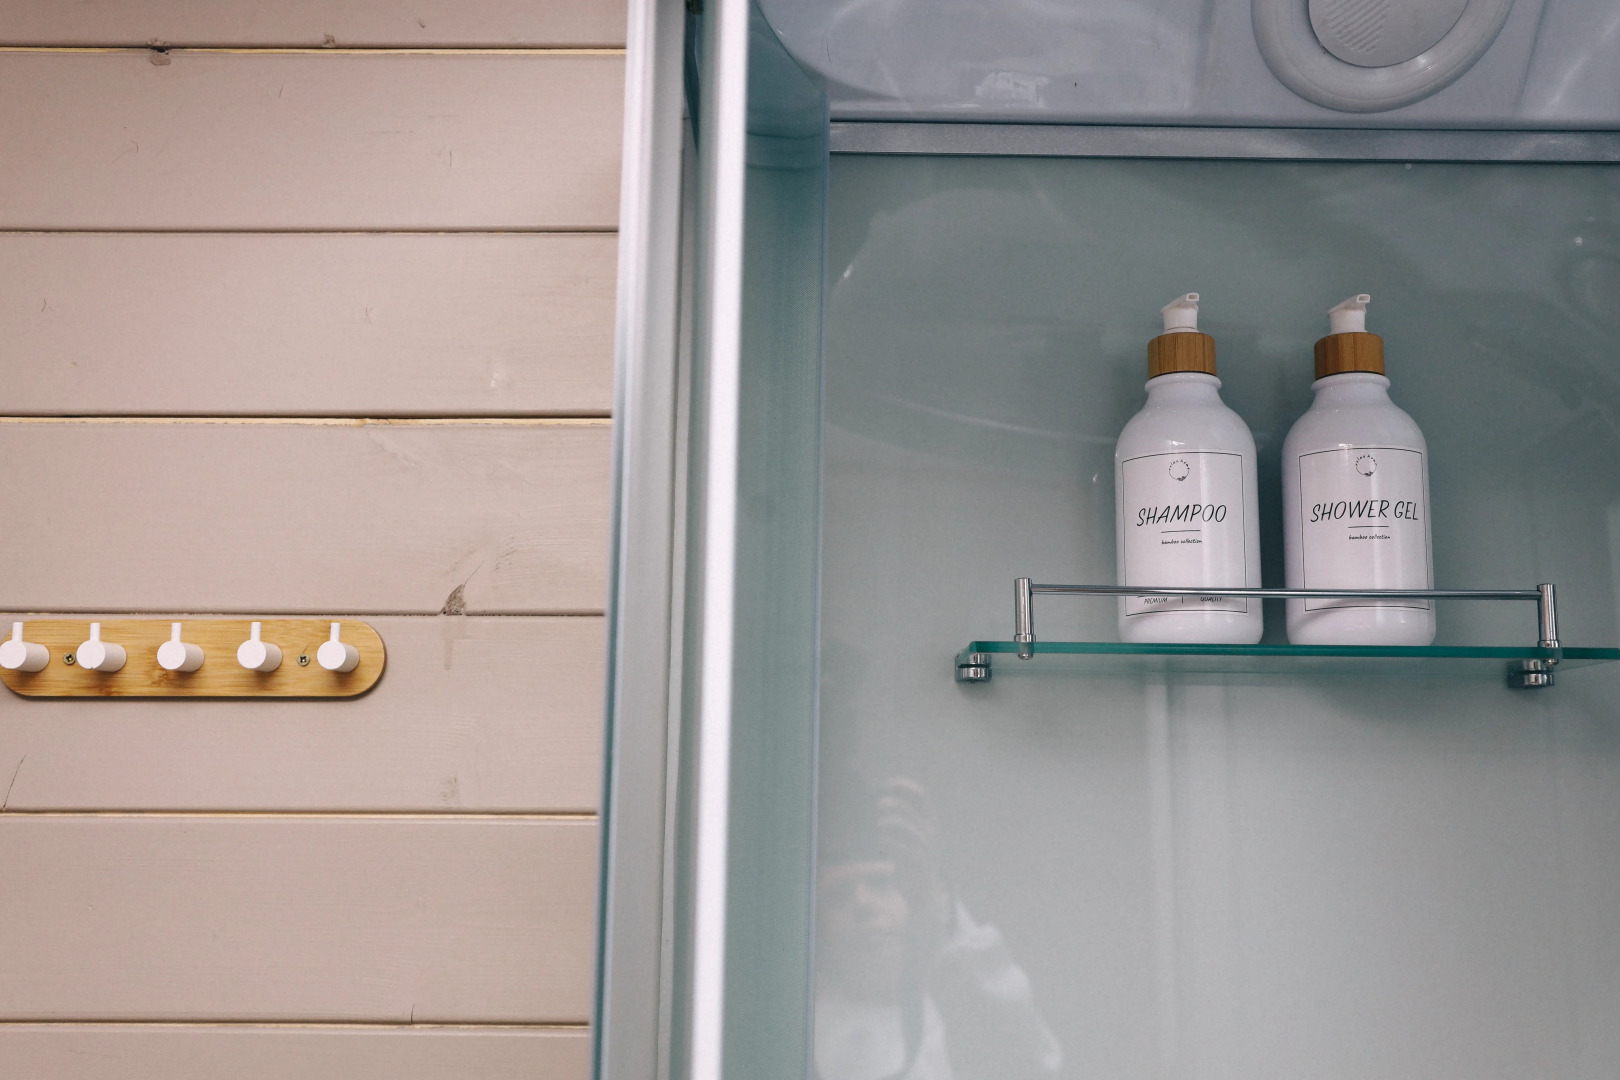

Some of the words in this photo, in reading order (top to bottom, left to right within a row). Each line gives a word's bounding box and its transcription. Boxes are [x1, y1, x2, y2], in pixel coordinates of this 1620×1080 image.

[1136, 504, 1227, 526] SHAMPOO
[1310, 500, 1390, 522] SHOWER
[1394, 500, 1419, 521] GEL
